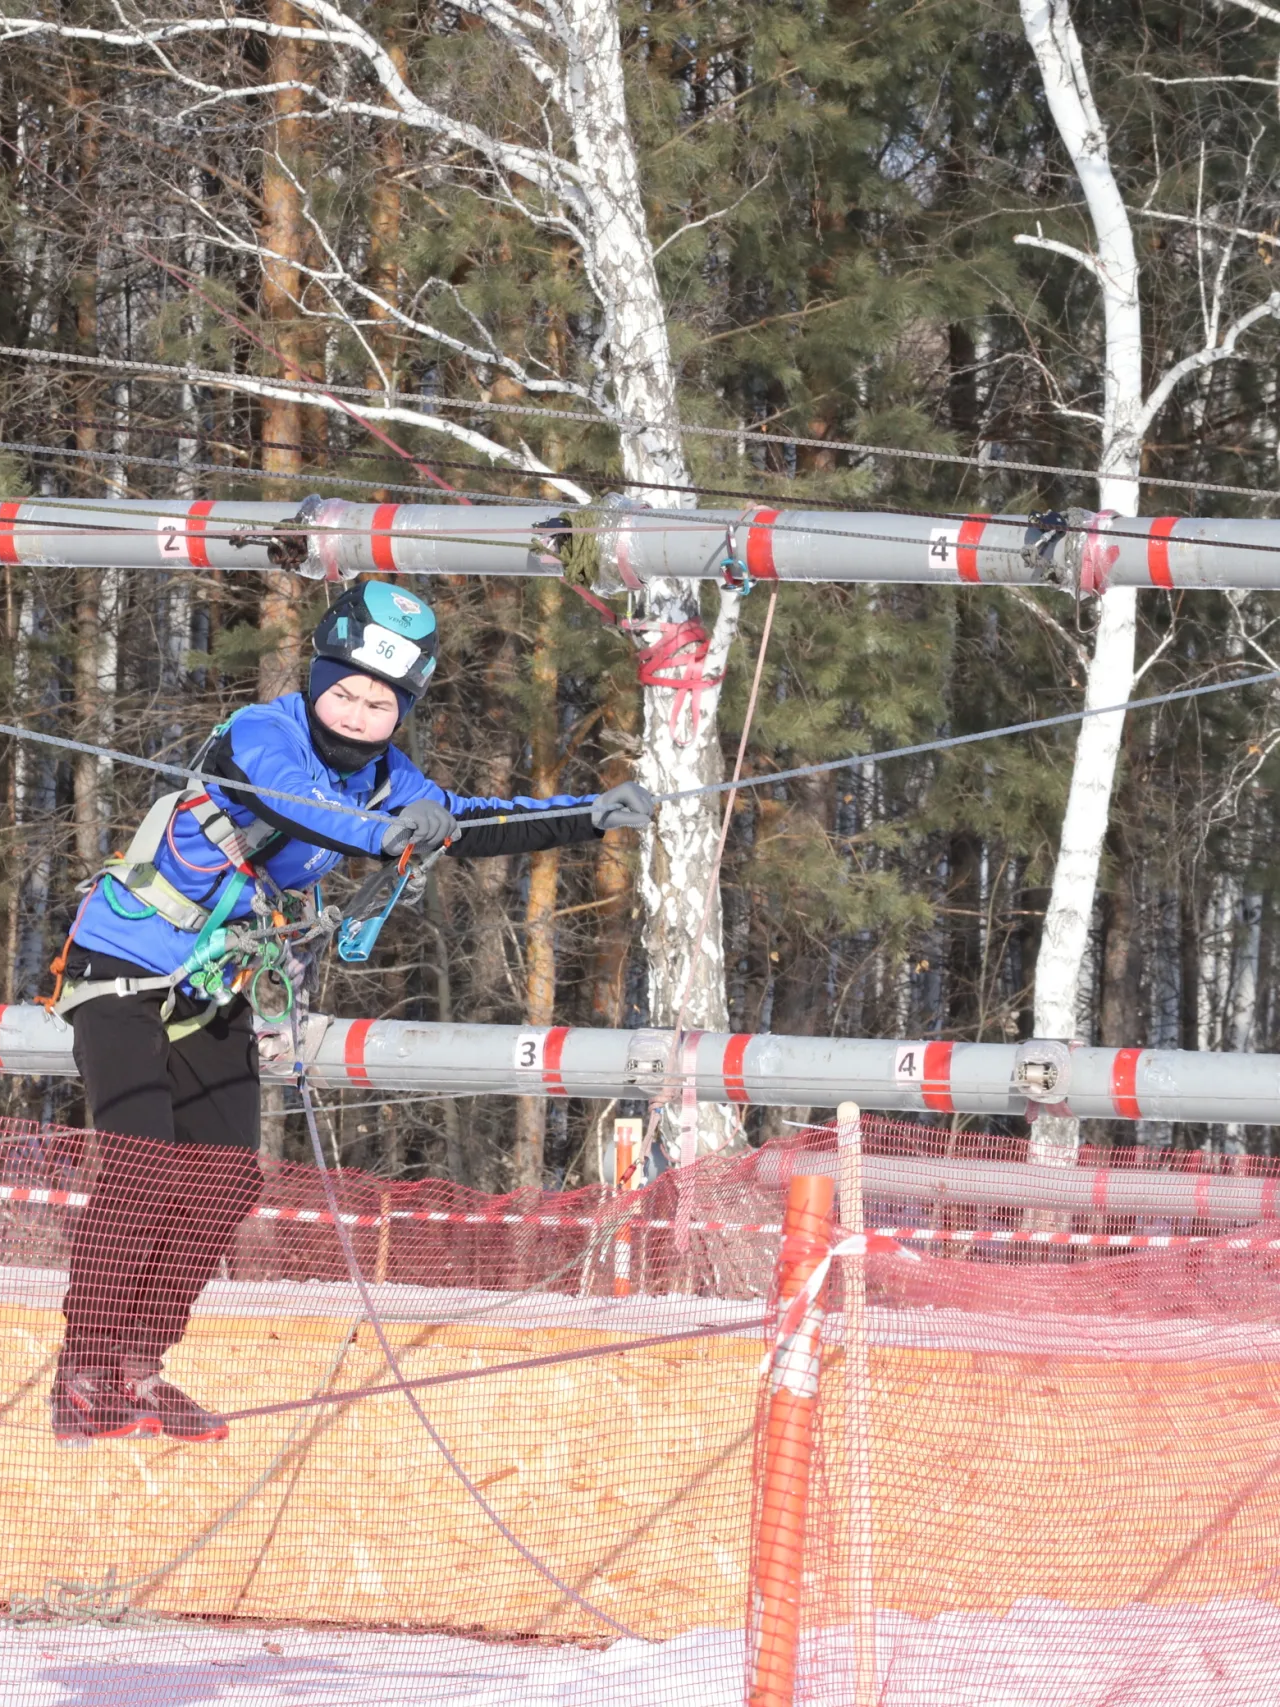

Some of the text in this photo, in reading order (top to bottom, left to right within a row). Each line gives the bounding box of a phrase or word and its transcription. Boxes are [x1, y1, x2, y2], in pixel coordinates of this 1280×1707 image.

[162, 525, 180, 551] 2
[931, 535, 949, 562] 4
[375, 640, 396, 659] 56
[520, 1041, 537, 1067] 3
[898, 1052, 916, 1077] 4
